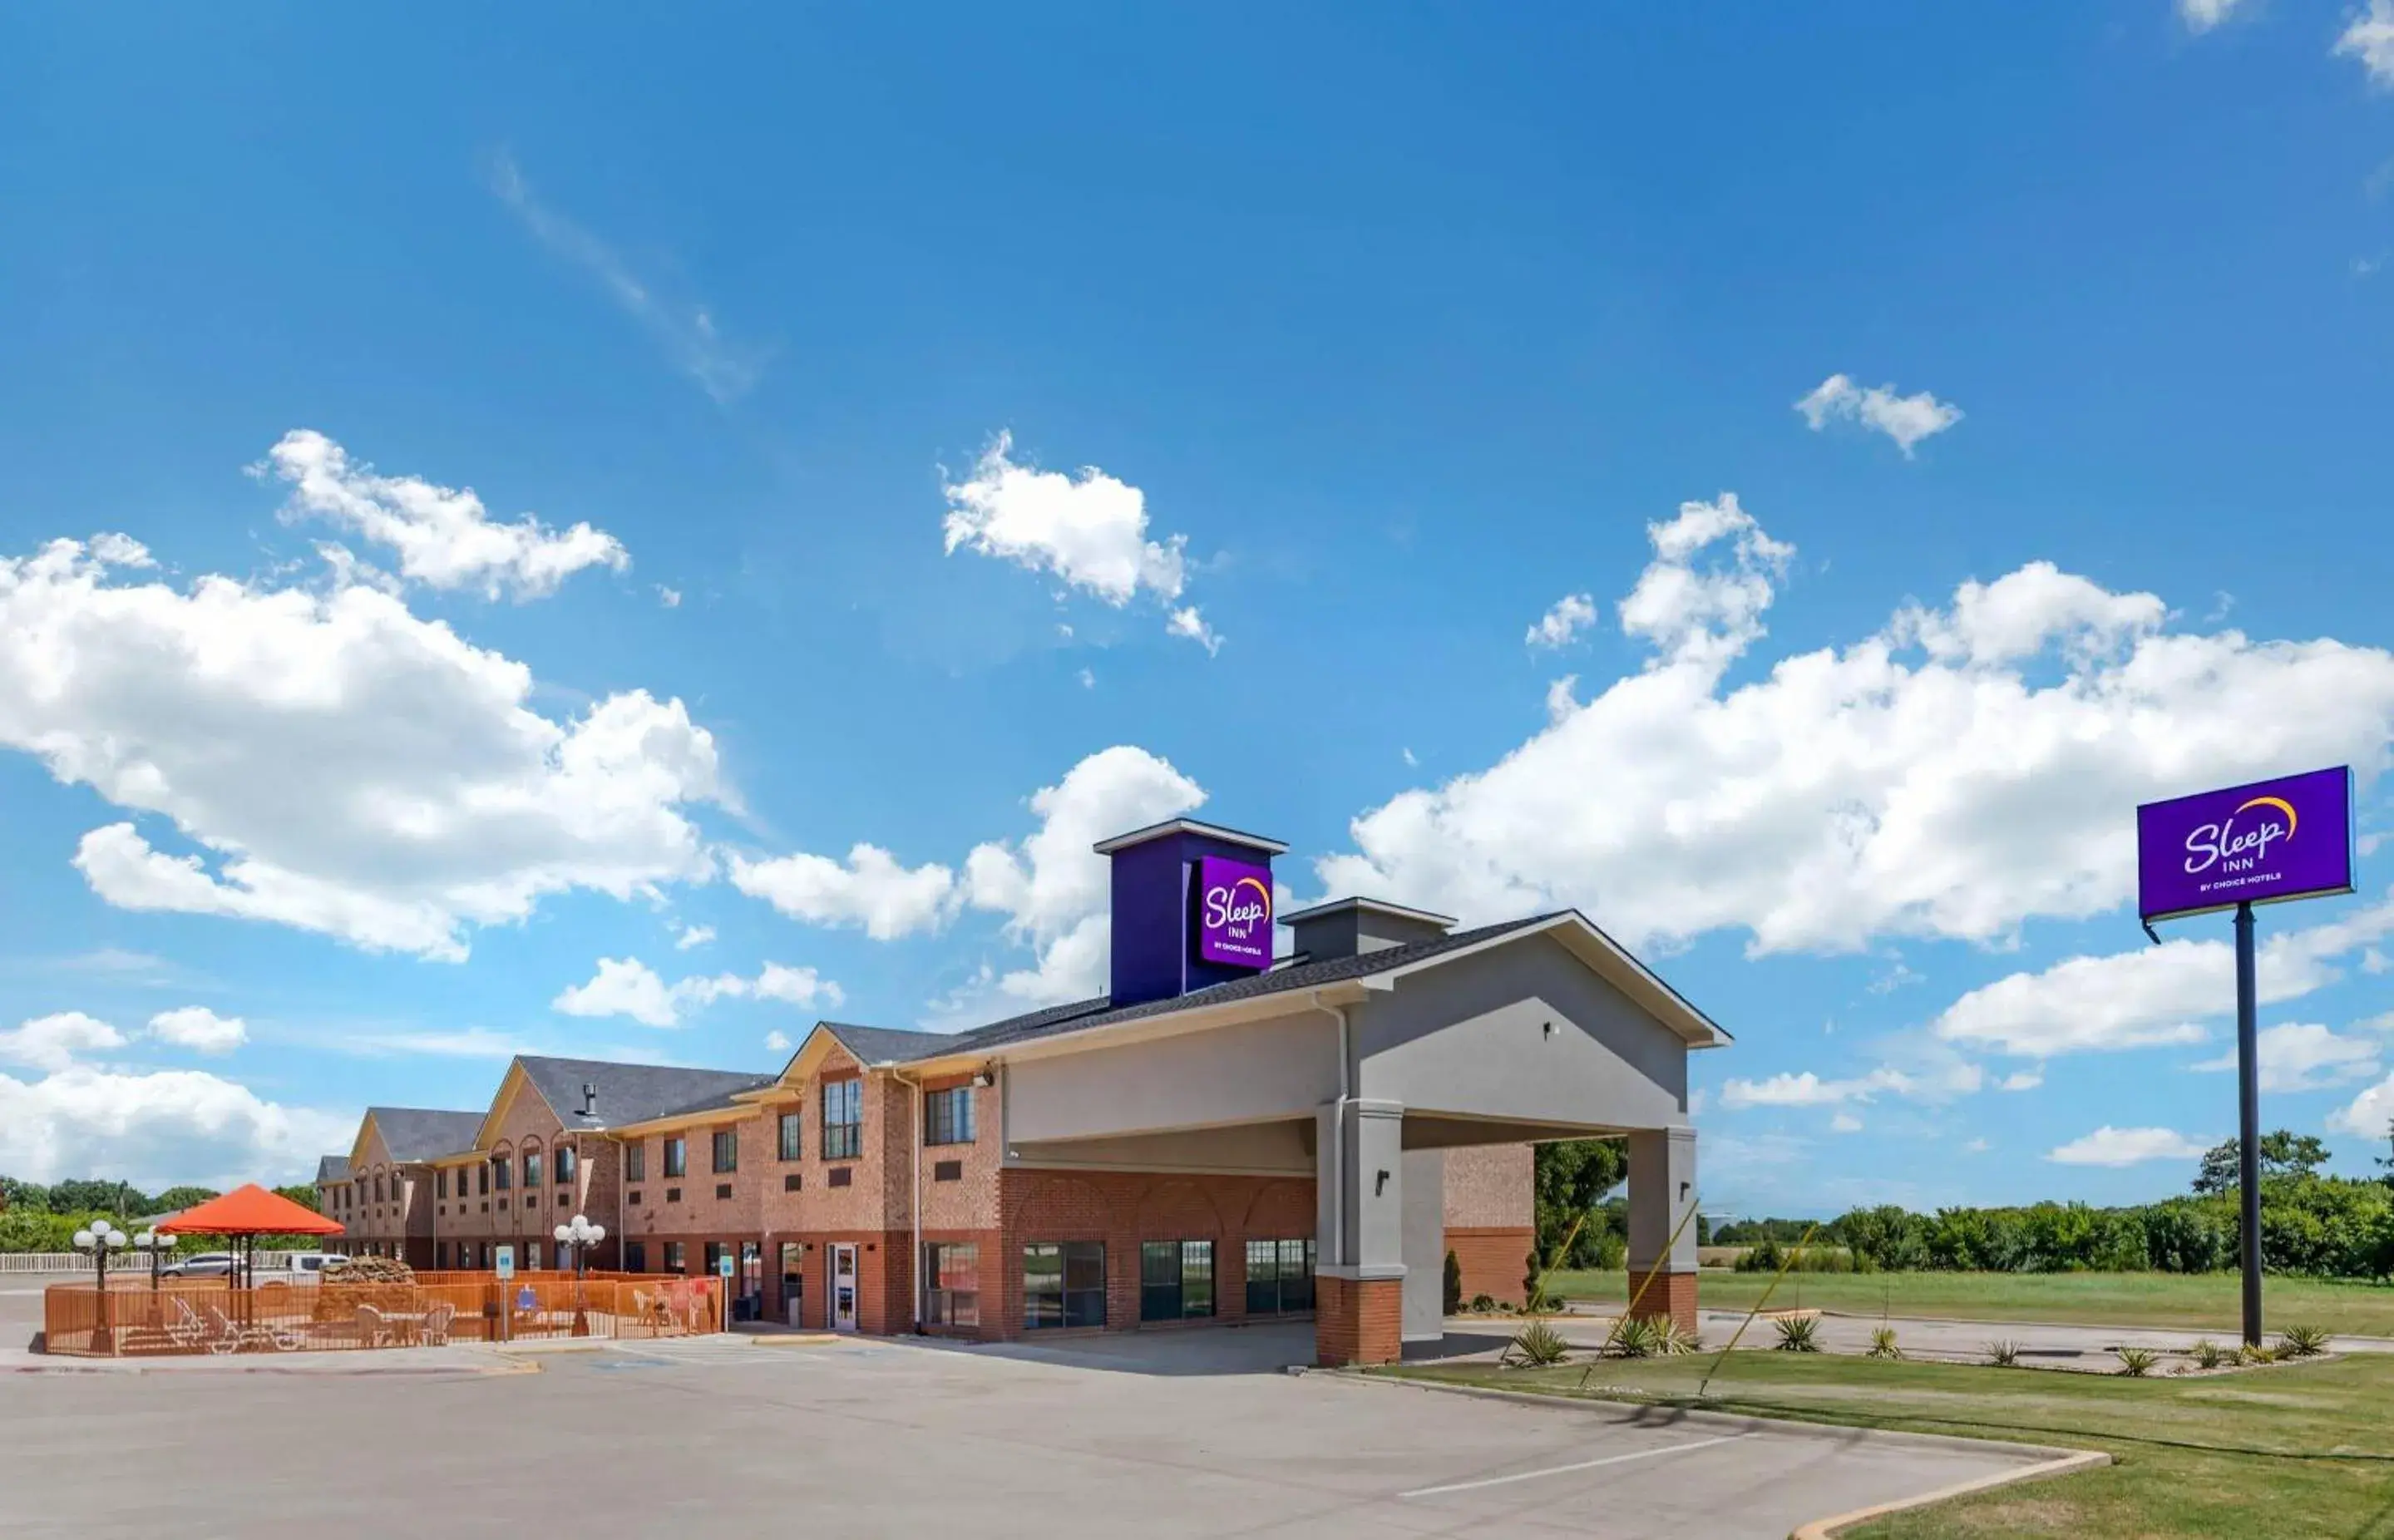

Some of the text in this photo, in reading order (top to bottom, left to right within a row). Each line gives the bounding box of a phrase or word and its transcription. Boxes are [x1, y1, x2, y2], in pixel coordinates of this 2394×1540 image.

[2184, 818, 2285, 873] Sleep
[2223, 857, 2253, 873] INN
[2200, 872, 2282, 892] BY CHOICE HOTELS
[1206, 886, 1264, 933] Sleep
[1228, 926, 1246, 939] INN
